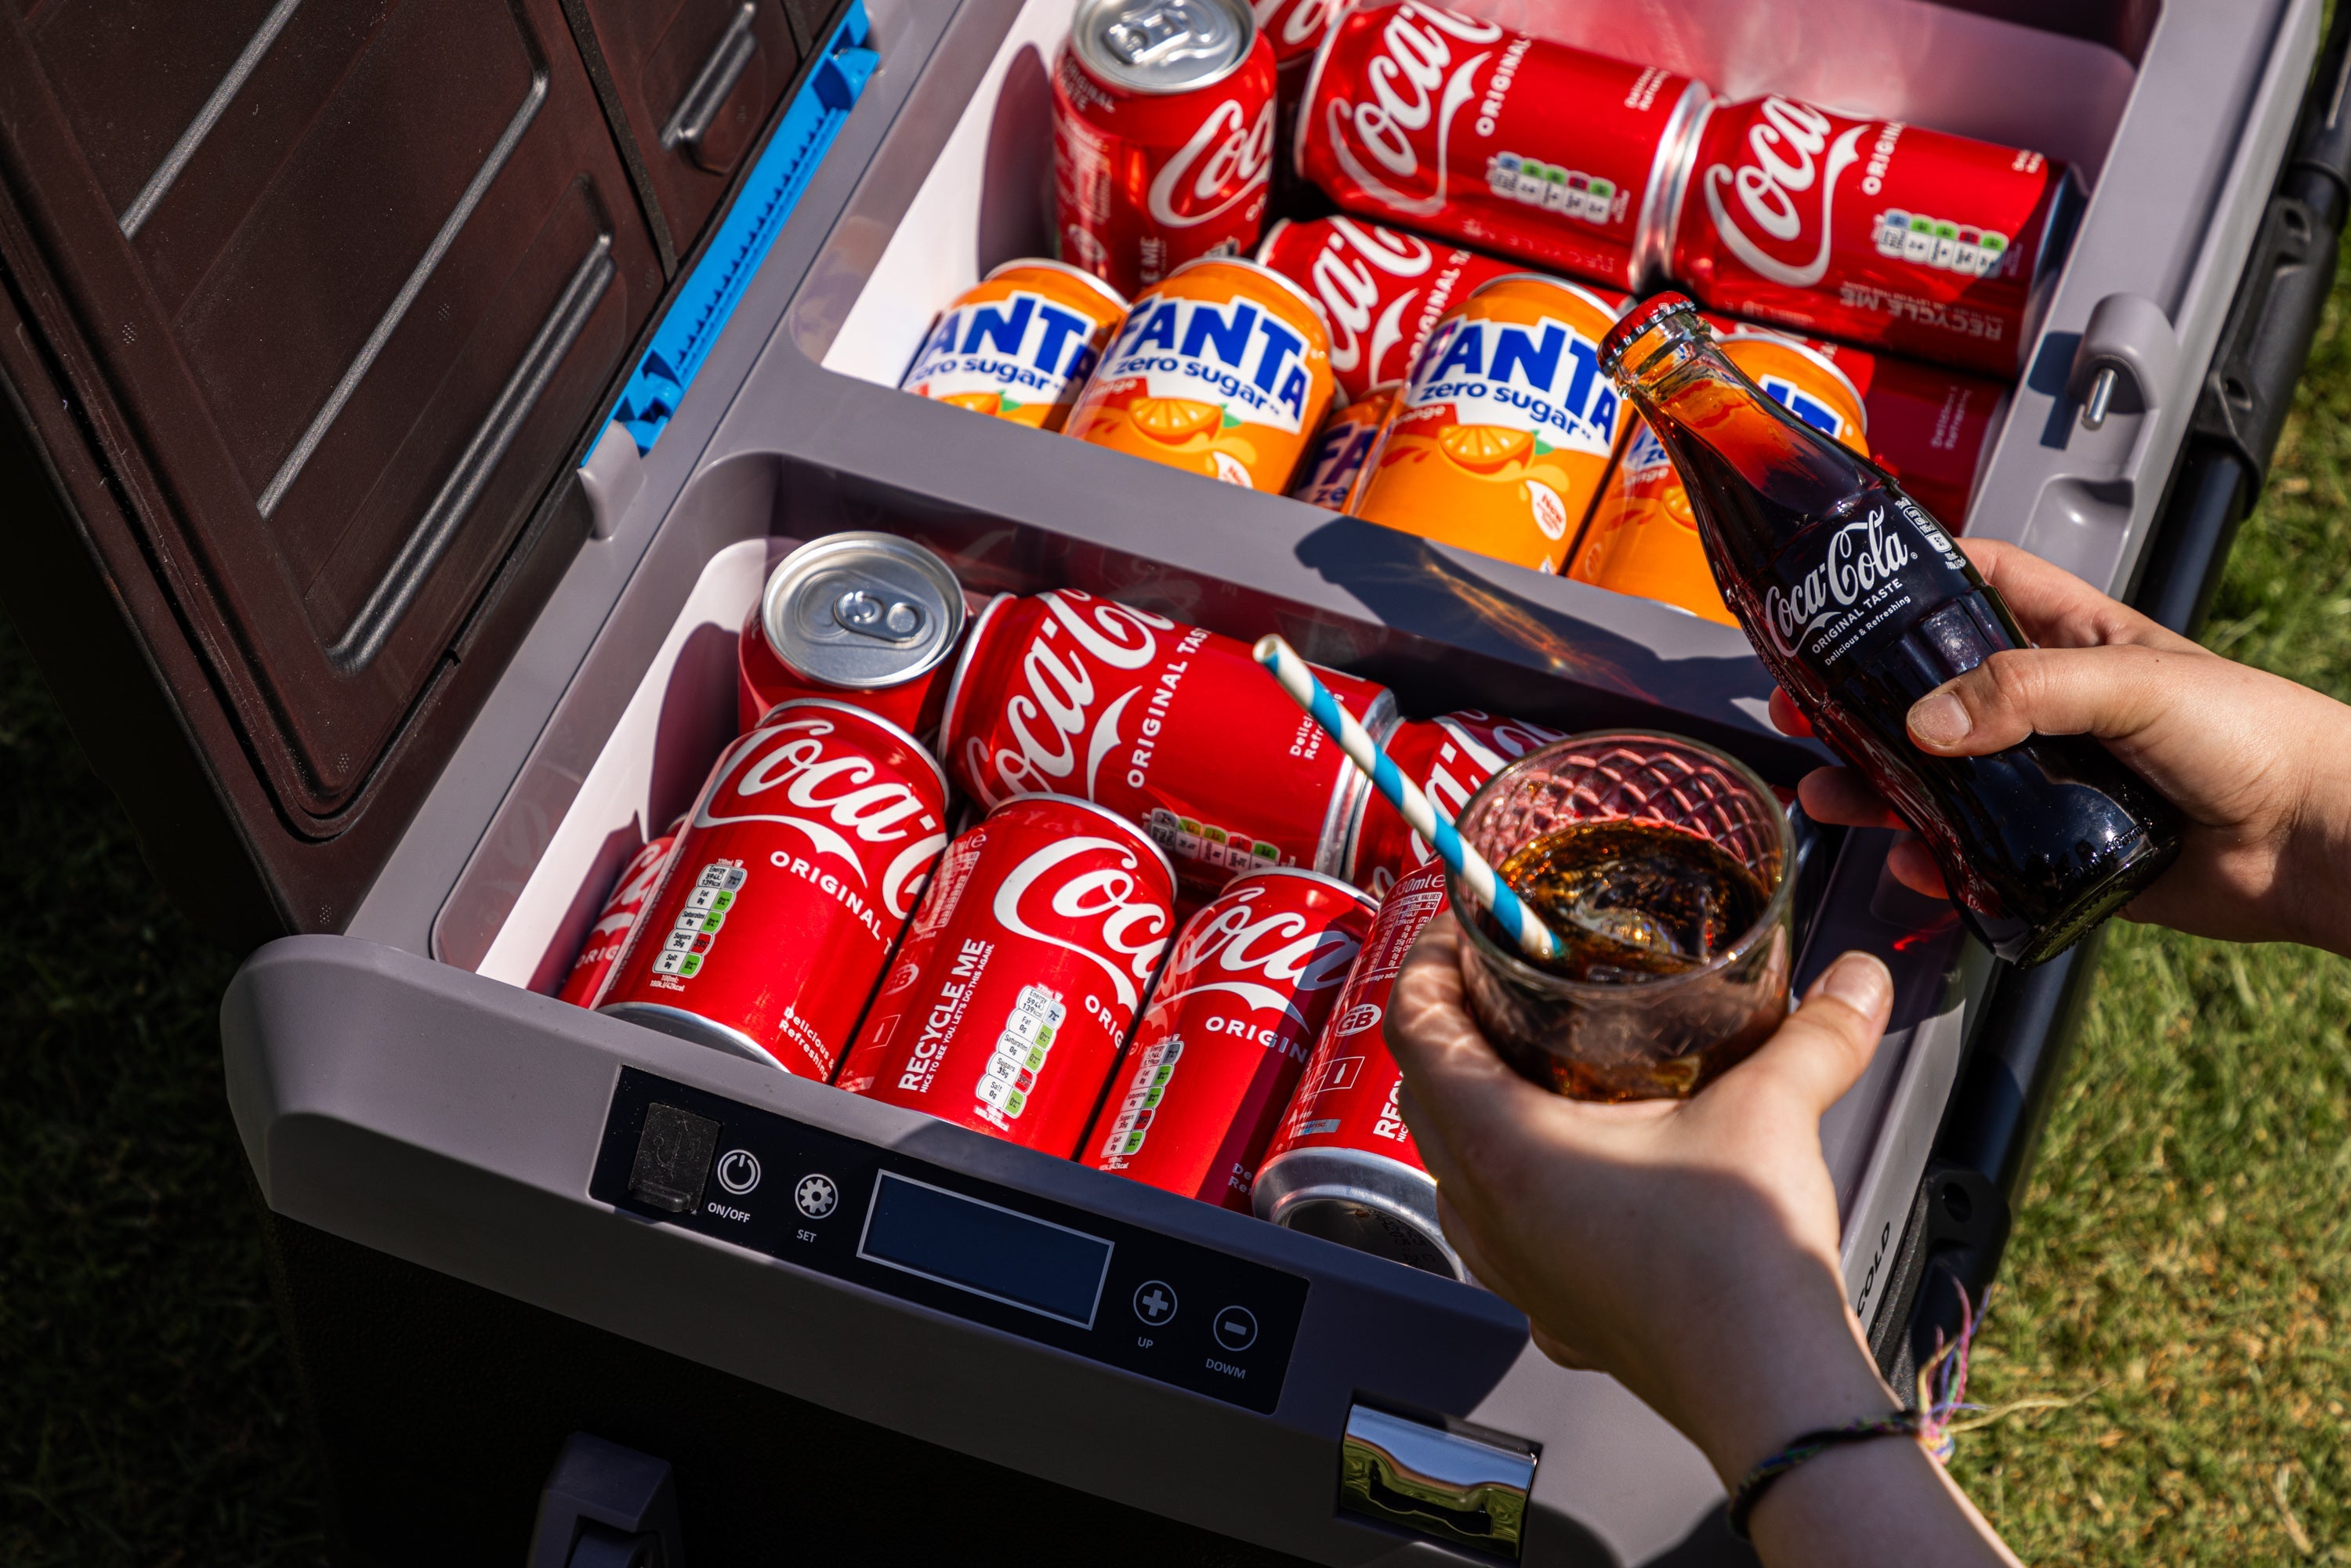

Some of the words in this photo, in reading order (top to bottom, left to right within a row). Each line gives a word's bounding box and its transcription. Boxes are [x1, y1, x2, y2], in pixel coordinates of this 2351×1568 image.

[1101, 298, 1307, 424] FANTA
[1112, 356, 1179, 375] zero
[1411, 317, 1617, 447] FANTA
[1419, 380, 1488, 402] zero
[1811, 608, 1865, 654] ORIGINAL
[1862, 578, 1904, 609] TASTE
[1824, 633, 1860, 666] Delicious
[1860, 628, 1867, 636] &
[1866, 595, 1911, 632] Refreshing
[1127, 661, 1188, 788] ORIGINAL
[770, 850, 881, 941] ORIGINAL
[673, 932, 692, 941] Sugars
[976, 942, 996, 971] AGAIN.
[967, 969, 983, 990] THIS
[962, 989, 974, 1004] DO
[1029, 990, 1048, 1004] Energy
[899, 982, 966, 1092] RECYCLE
[952, 937, 986, 979] ME
[951, 1001, 969, 1026] LET'S
[1023, 1003, 1043, 1019] 139kcal
[1019, 1023, 1027, 1034] 0g
[1022, 1016, 1031, 1027] Fat
[1339, 1012, 1375, 1032] GB
[783, 1006, 829, 1060] Delicious
[941, 1023, 958, 1045] YOU.
[1004, 1034, 1028, 1052] Saturates
[1205, 1016, 1308, 1063] ORIGIN
[778, 1019, 829, 1082] Refreshing
[933, 1043, 948, 1062] SEE
[1009, 1046, 1016, 1056] 0g
[928, 1059, 940, 1074] TO
[997, 1058, 1016, 1073] Sugars
[997, 1066, 1009, 1079] 35g
[918, 1072, 935, 1095] NICE
[991, 1081, 1003, 1092] Salt
[989, 1090, 997, 1099] 0g
[1119, 1114, 1134, 1124] Sugars
[708, 1202, 751, 1223] ON/OFF
[796, 1229, 817, 1243] SET
[1857, 1221, 1890, 1318] COLD
[1137, 1336, 1154, 1349] UP
[1205, 1358, 1246, 1379] DOWM
